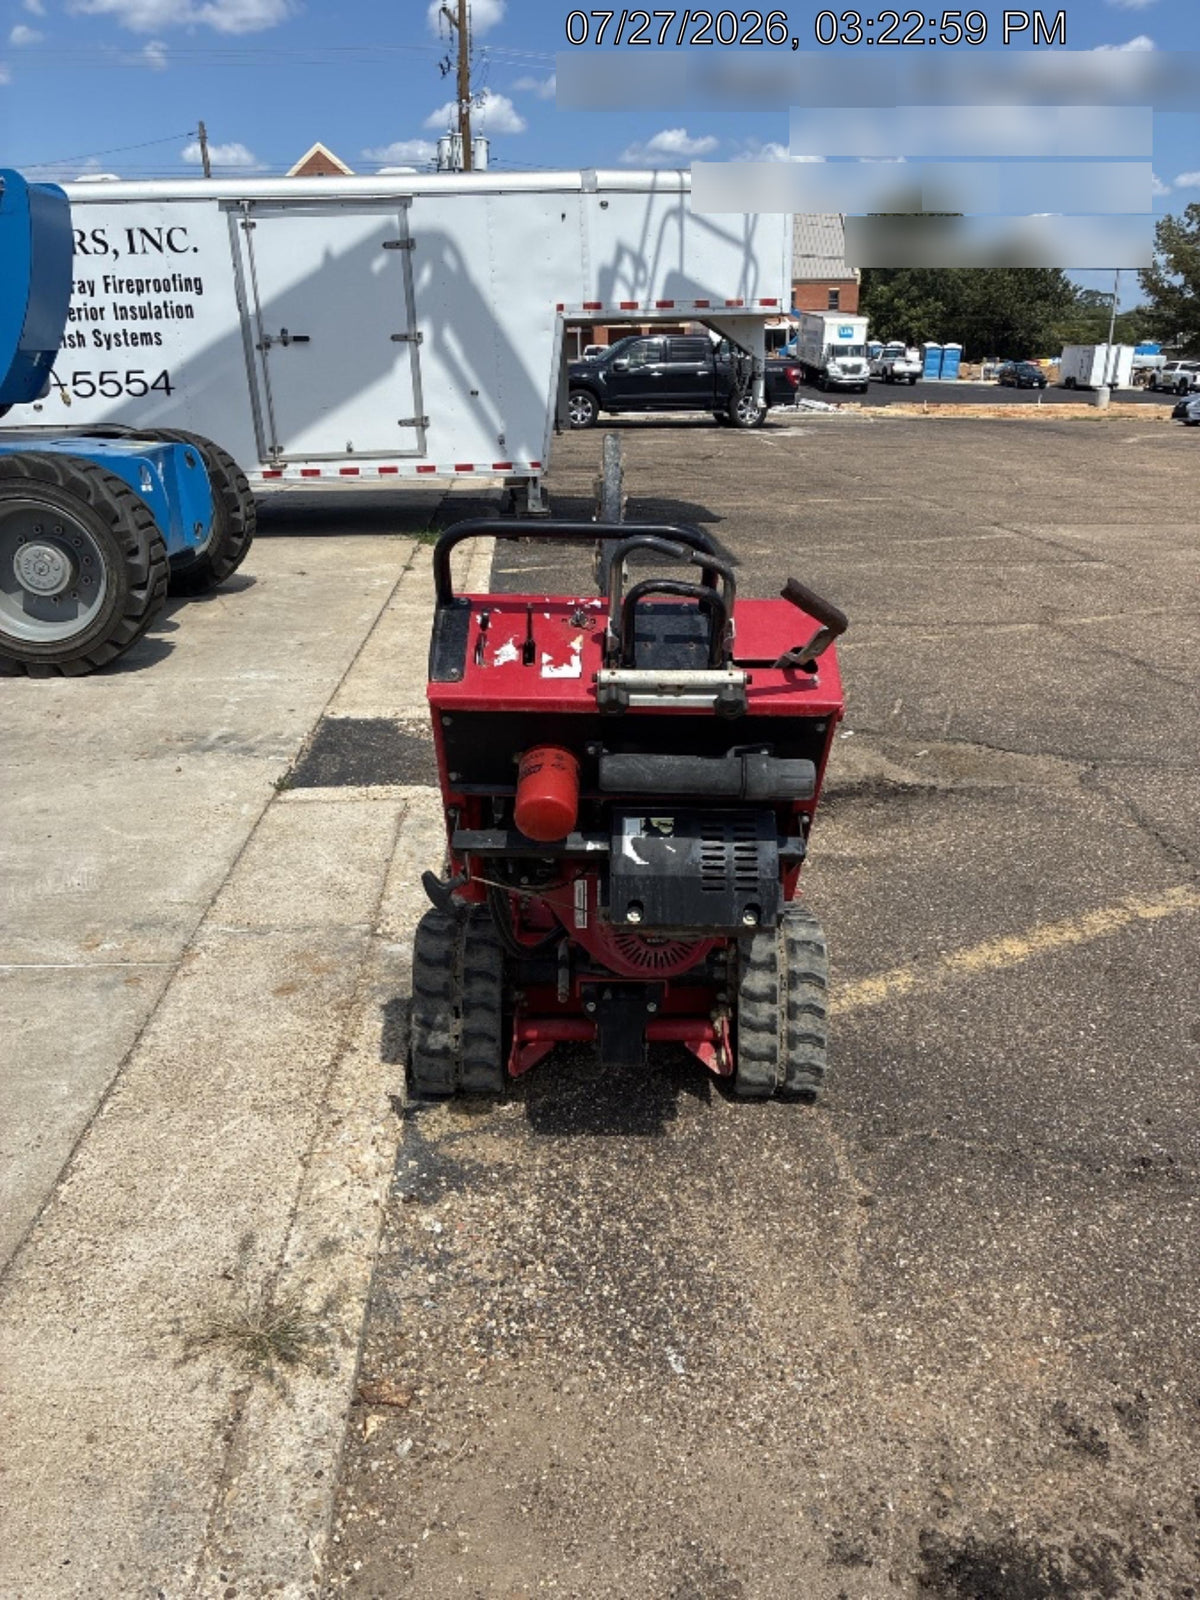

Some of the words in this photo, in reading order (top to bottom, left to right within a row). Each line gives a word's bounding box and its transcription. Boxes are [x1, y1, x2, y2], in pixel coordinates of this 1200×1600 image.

[126, 227, 199, 254] INC.
[103, 273, 204, 296] Fireproofing
[113, 300, 195, 321] Insulation
[93, 329, 163, 350] Systems
